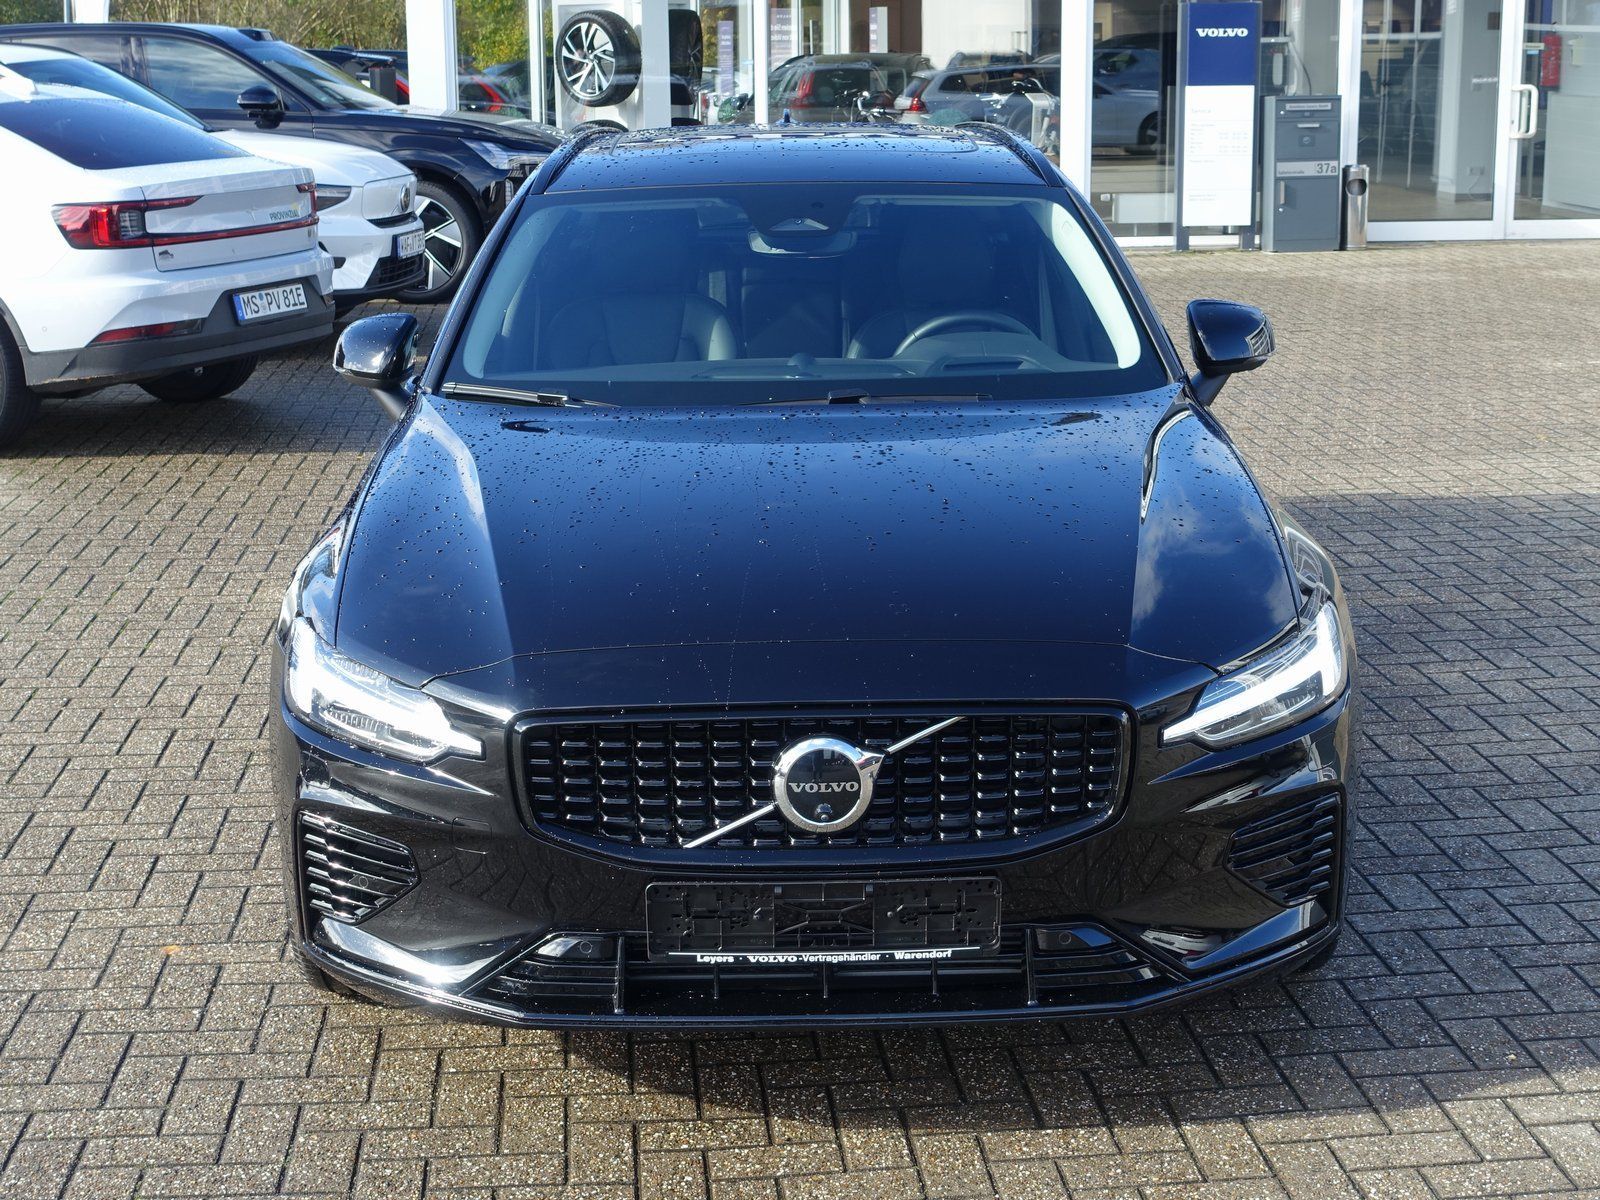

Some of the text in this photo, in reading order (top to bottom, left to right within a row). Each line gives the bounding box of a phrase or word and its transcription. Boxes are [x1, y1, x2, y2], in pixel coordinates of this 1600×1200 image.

[1196, 28, 1249, 37] VOLVO
[1316, 163, 1337, 174] 37a
[242, 287, 306, 316] MS PV 81E
[788, 781, 859, 793] VOLVO
[696, 954, 735, 964] Leyers
[894, 949, 953, 960] Warendorf
